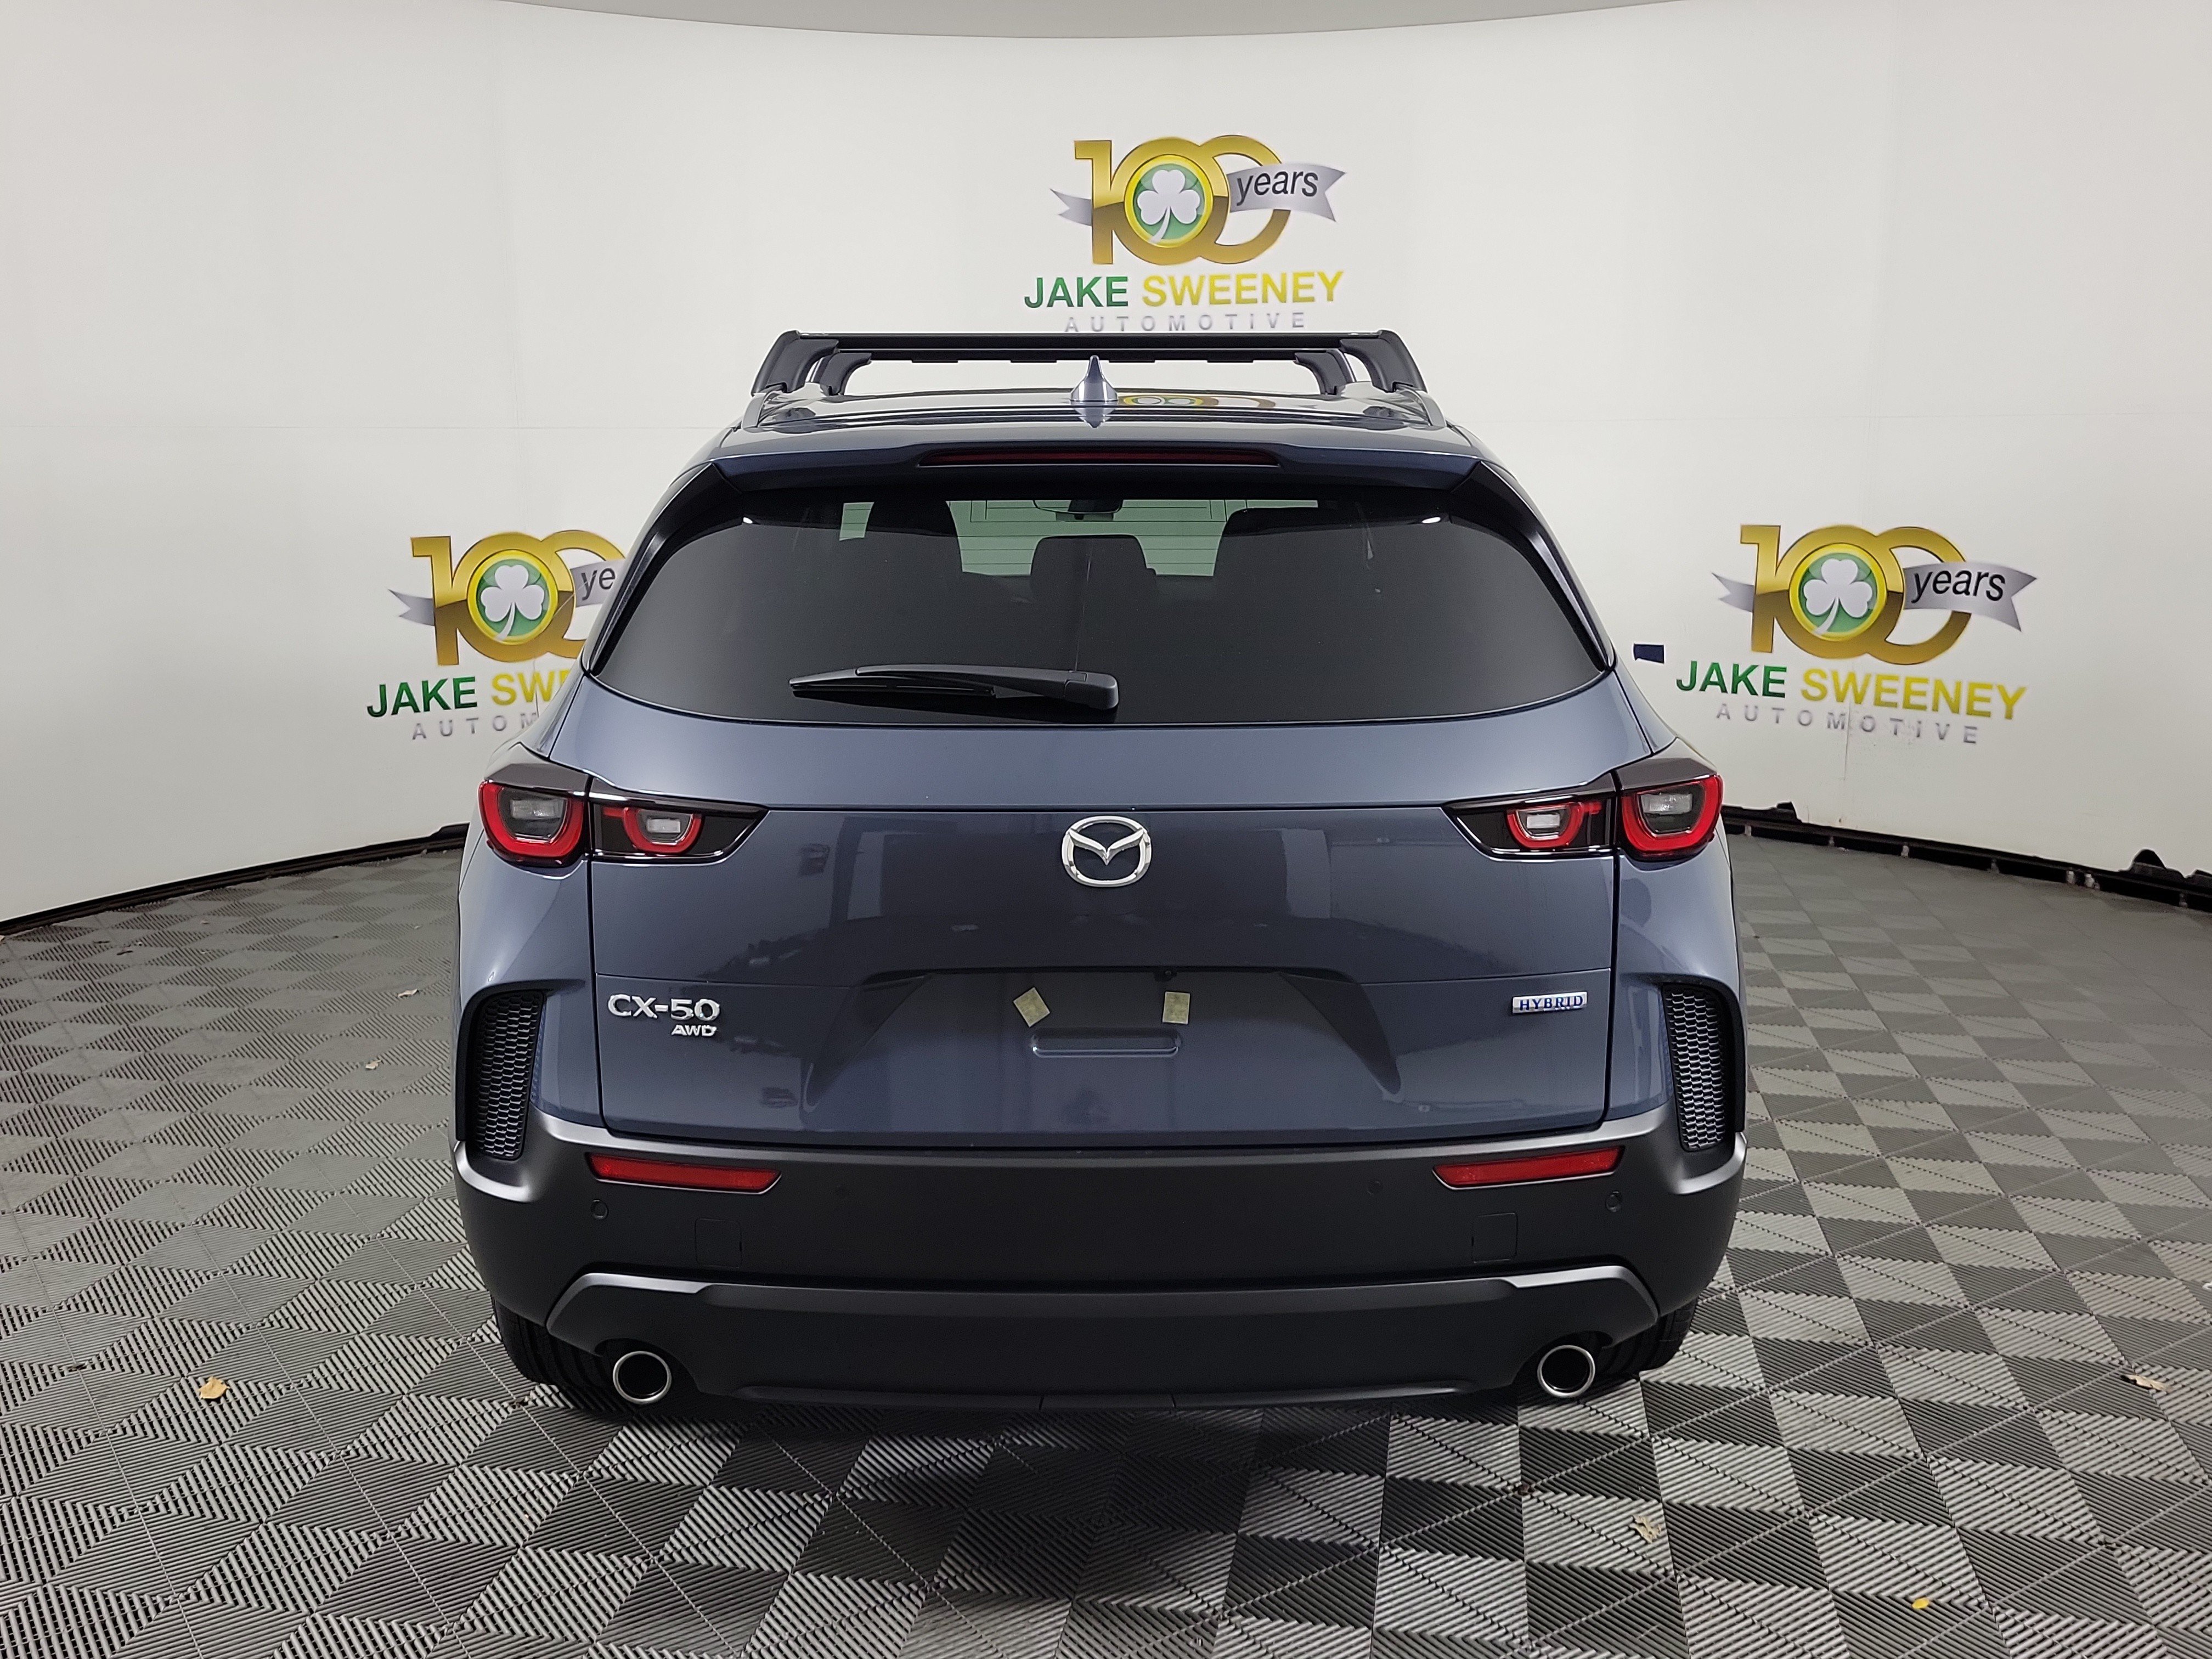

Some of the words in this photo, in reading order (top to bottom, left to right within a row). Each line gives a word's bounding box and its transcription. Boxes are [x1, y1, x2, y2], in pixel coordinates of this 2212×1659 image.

[1235, 168, 1319, 206] years
[1024, 276, 1128, 308] JAKE
[1142, 270, 1344, 307] SWEENEY
[1064, 312, 1305, 332] AUTOMOTIVE
[1910, 567, 2006, 603] years
[366, 675, 478, 717] JAKE
[1676, 660, 1787, 698] JAKE
[1801, 668, 2027, 720] SWEENEY
[1716, 703, 1979, 744] AUTOMOTIVE
[608, 994, 721, 1022] CX-50
[1519, 995, 1583, 1011] HYBRID
[671, 1024, 718, 1037] AWD
